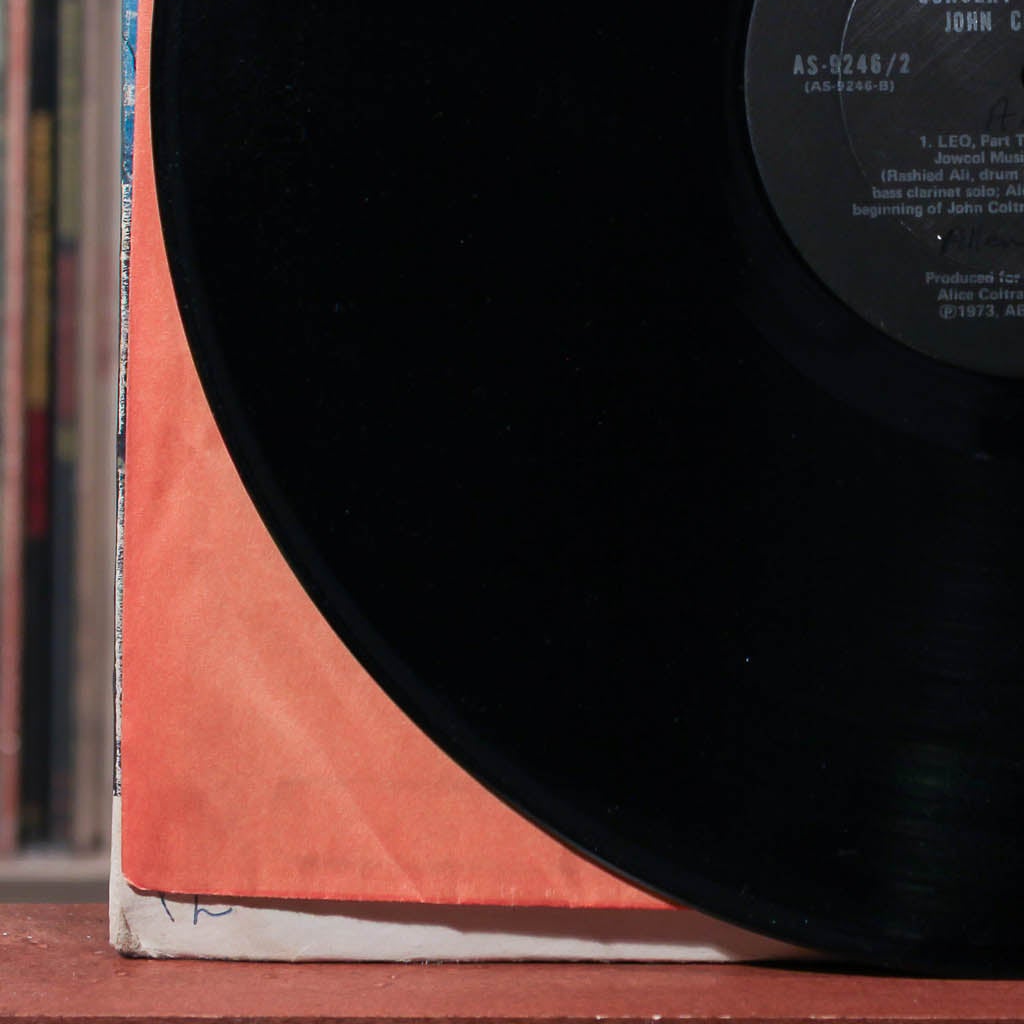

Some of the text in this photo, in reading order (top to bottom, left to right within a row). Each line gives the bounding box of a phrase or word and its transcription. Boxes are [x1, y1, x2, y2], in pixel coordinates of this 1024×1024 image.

[944, 10, 993, 33] JOHN
[793, 52, 912, 77] AS-9246/2
[920, 135, 932, 148] 1.
[938, 134, 976, 149] LEO,
[980, 134, 1010, 147] Part
[934, 151, 985, 165] Jowcol
[880, 168, 944, 182] (Rashied
[949, 168, 975, 182] Ali,
[978, 168, 1019, 181] drum
[872, 186, 903, 199] bass
[906, 185, 961, 198] clarinet
[965, 184, 1000, 198] solo;
[852, 202, 923, 218] beginning
[927, 201, 943, 215] of
[947, 201, 983, 214] John
[925, 270, 995, 285] Produced
[999, 270, 1020, 284] for
[937, 287, 974, 301] Alice
